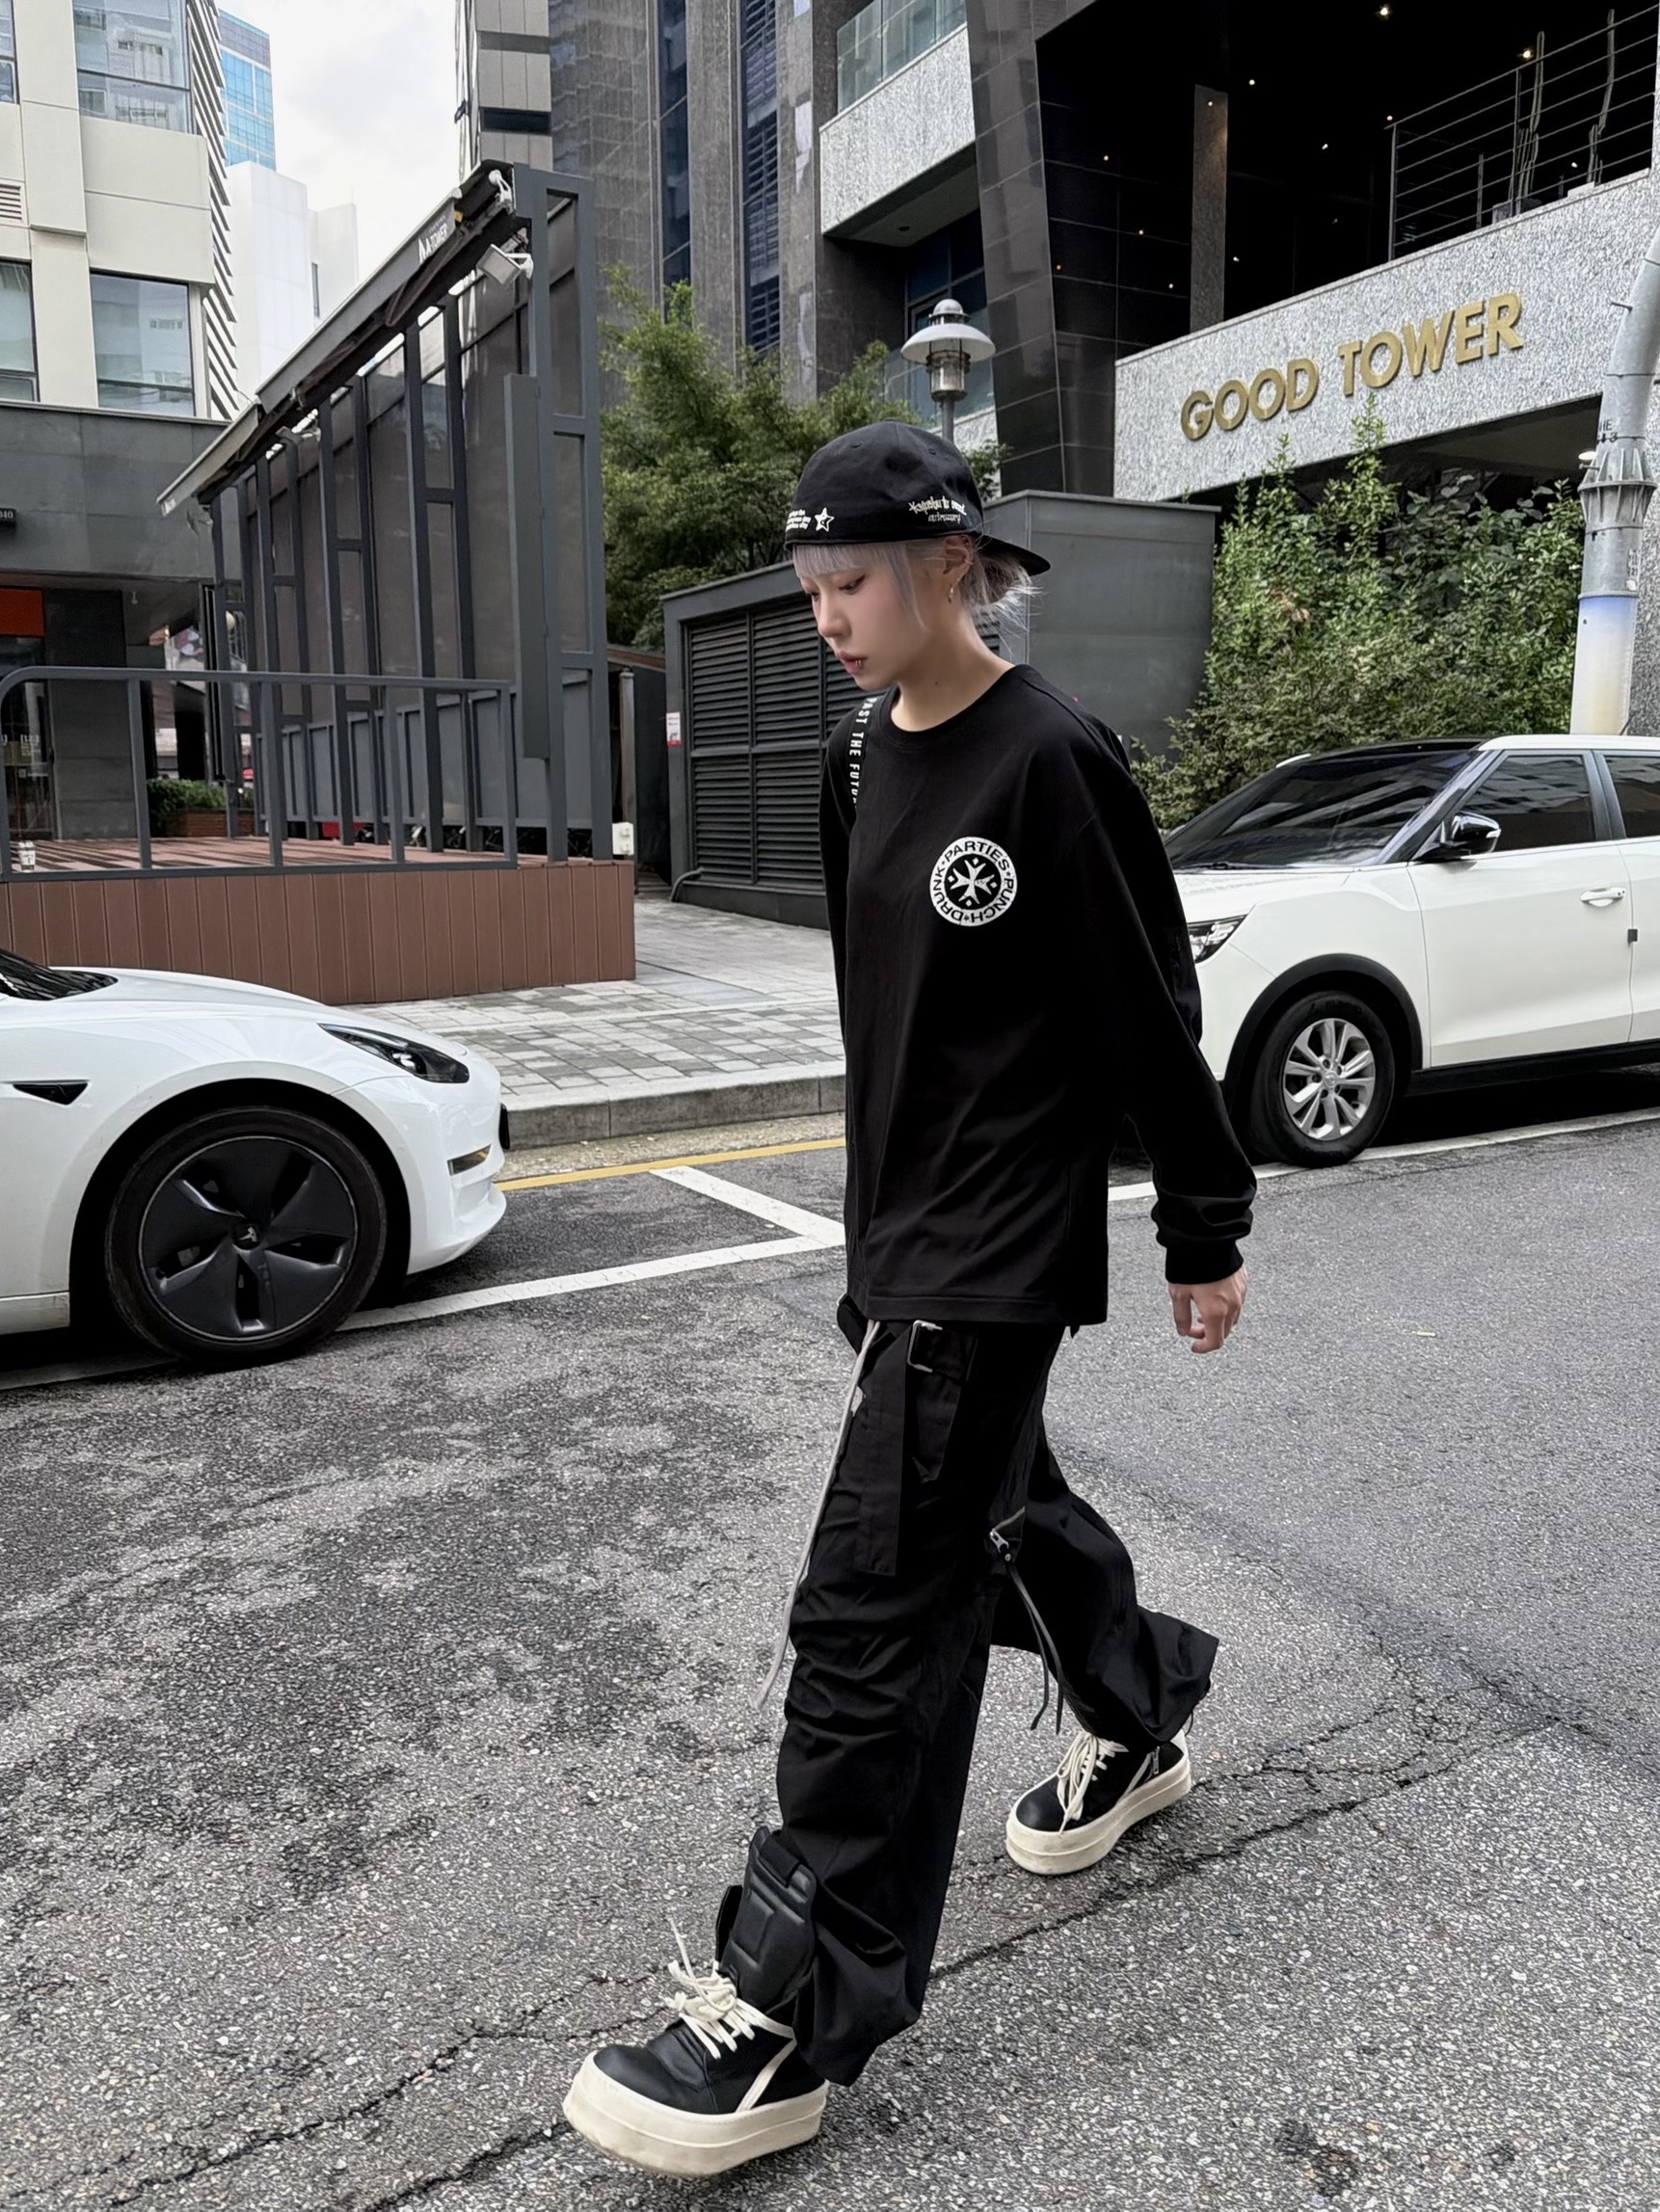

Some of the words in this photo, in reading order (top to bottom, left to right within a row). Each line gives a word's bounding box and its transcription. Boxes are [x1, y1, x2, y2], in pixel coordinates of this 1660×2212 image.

[1181, 358, 1320, 440] GOOD
[1338, 293, 1524, 396] TOWER
[849, 732, 865, 757] THE
[945, 840, 1010, 871] PARTIES
[932, 866, 964, 922] DRUNK
[970, 877, 1014, 923] PUNCH
